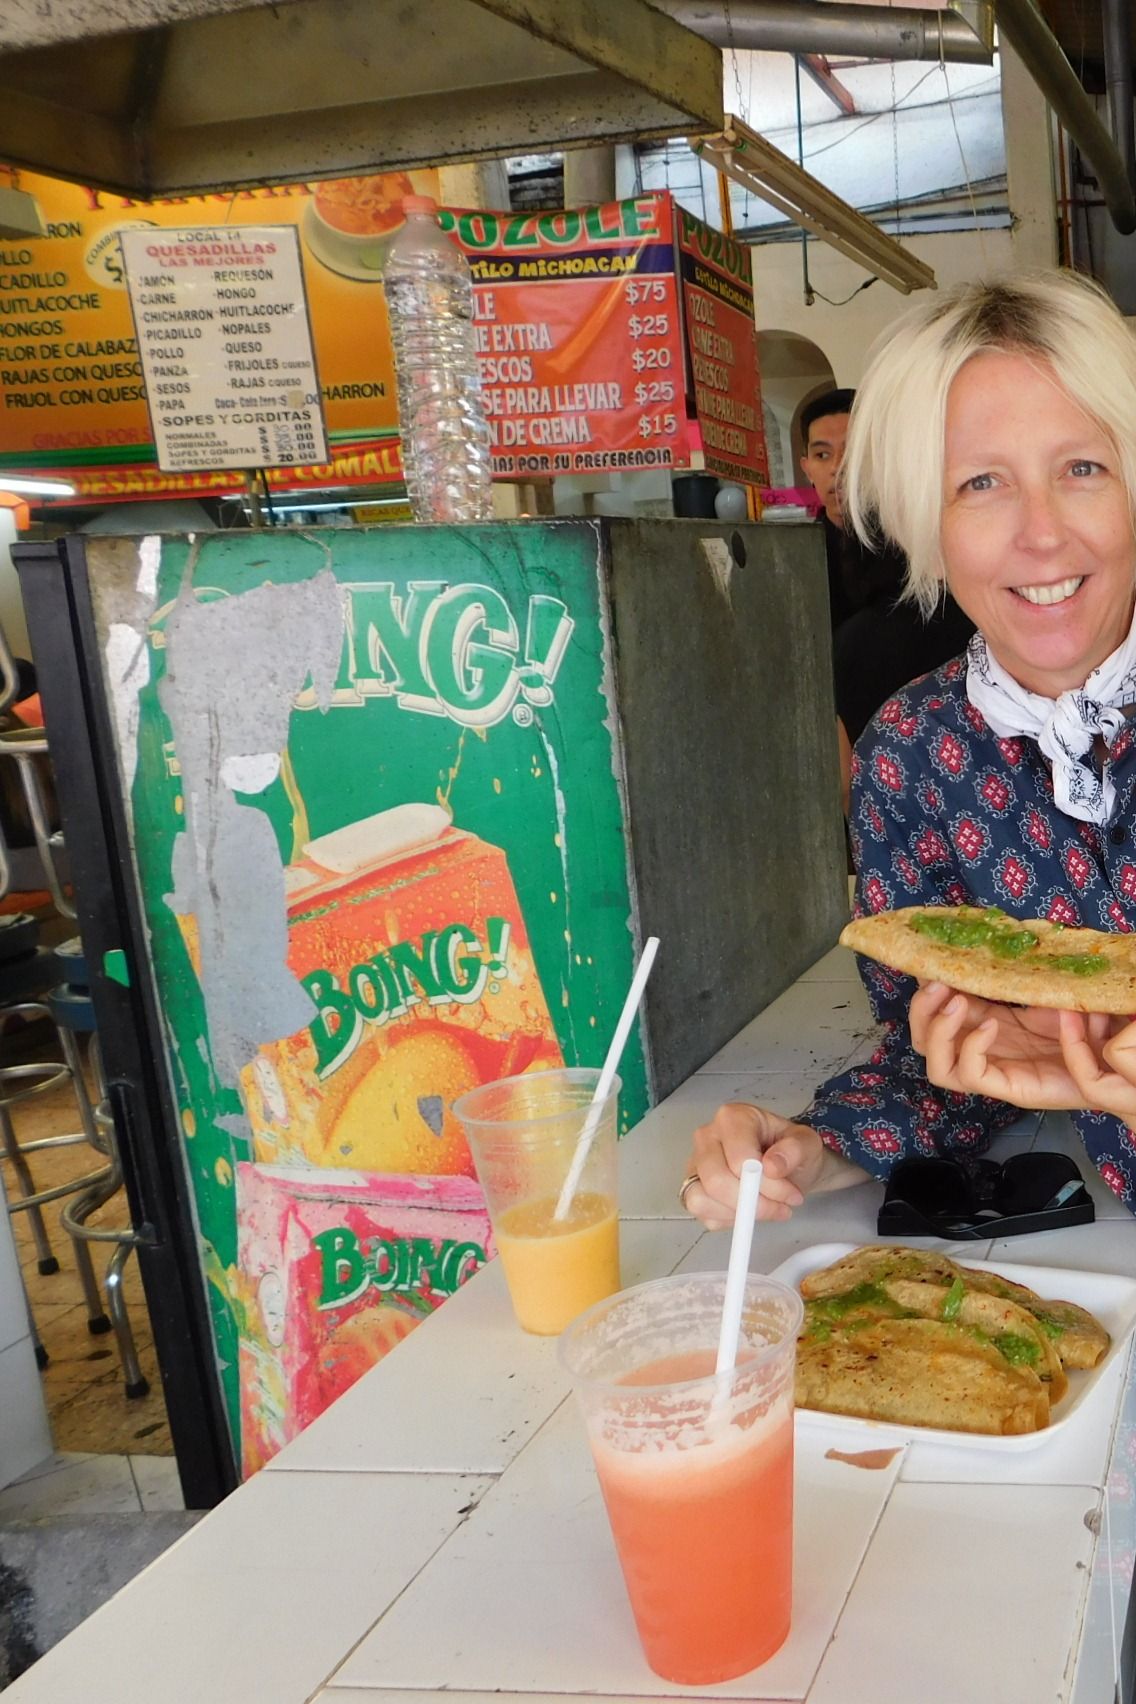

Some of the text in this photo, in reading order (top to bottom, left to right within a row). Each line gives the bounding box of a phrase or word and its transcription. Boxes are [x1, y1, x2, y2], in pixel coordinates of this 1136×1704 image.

[177, 231, 221, 244] LOCAL
[146, 242, 278, 258] QUESADILLAS
[0, 250, 32, 267] LLO
[159, 255, 266, 268] LAS MEJORES
[0, 272, 67, 290] CADILLO
[140, 293, 177, 305] CARNE
[216, 287, 257, 300] HONGO
[625, 279, 667, 306] $75
[0, 293, 101, 314] UITLACOCHE
[219, 303, 296, 318] HUITLACOCHE
[143, 309, 215, 324] CHICHARRON
[222, 322, 271, 336] NOPALES
[628, 313, 670, 340] $25
[146, 327, 202, 342] PICADILLO
[493, 323, 553, 352] EXTRA
[0, 338, 138, 361] FLOR DE CALABAZ
[149, 347, 185, 360] POLLO
[225, 341, 263, 355] QUESO
[228, 358, 279, 372] FRIJOLES
[632, 347, 672, 374] $20
[2, 361, 144, 385] RAJAS CON QUESO
[153, 365, 189, 378] PANZA
[479, 356, 533, 385] ESCOS
[156, 382, 192, 395] SESOS
[230, 377, 266, 389] RAJAS
[5, 383, 385, 408] FRIJOL CON QUESO HARRON
[506, 385, 552, 415] PARA
[554, 381, 623, 412] LLEVAR
[634, 380, 675, 407] $25
[159, 398, 185, 411] PAPA
[162, 410, 312, 427] SOPES Y GORDITAS
[166, 431, 217, 441] NORMALES
[503, 419, 527, 447] DE
[529, 415, 592, 446] CREMA
[638, 413, 678, 439] $15
[167, 440, 229, 449] COMBINADAS
[209, 447, 257, 456] GORDITAS
[170, 457, 224, 467] REFRESCOS
[518, 456, 549, 473] POR
[554, 454, 570, 471] SU
[575, 448, 673, 471] PREFERENCIA
[300, 916, 512, 1082] BOING!
[313, 1226, 487, 1311] BOING
